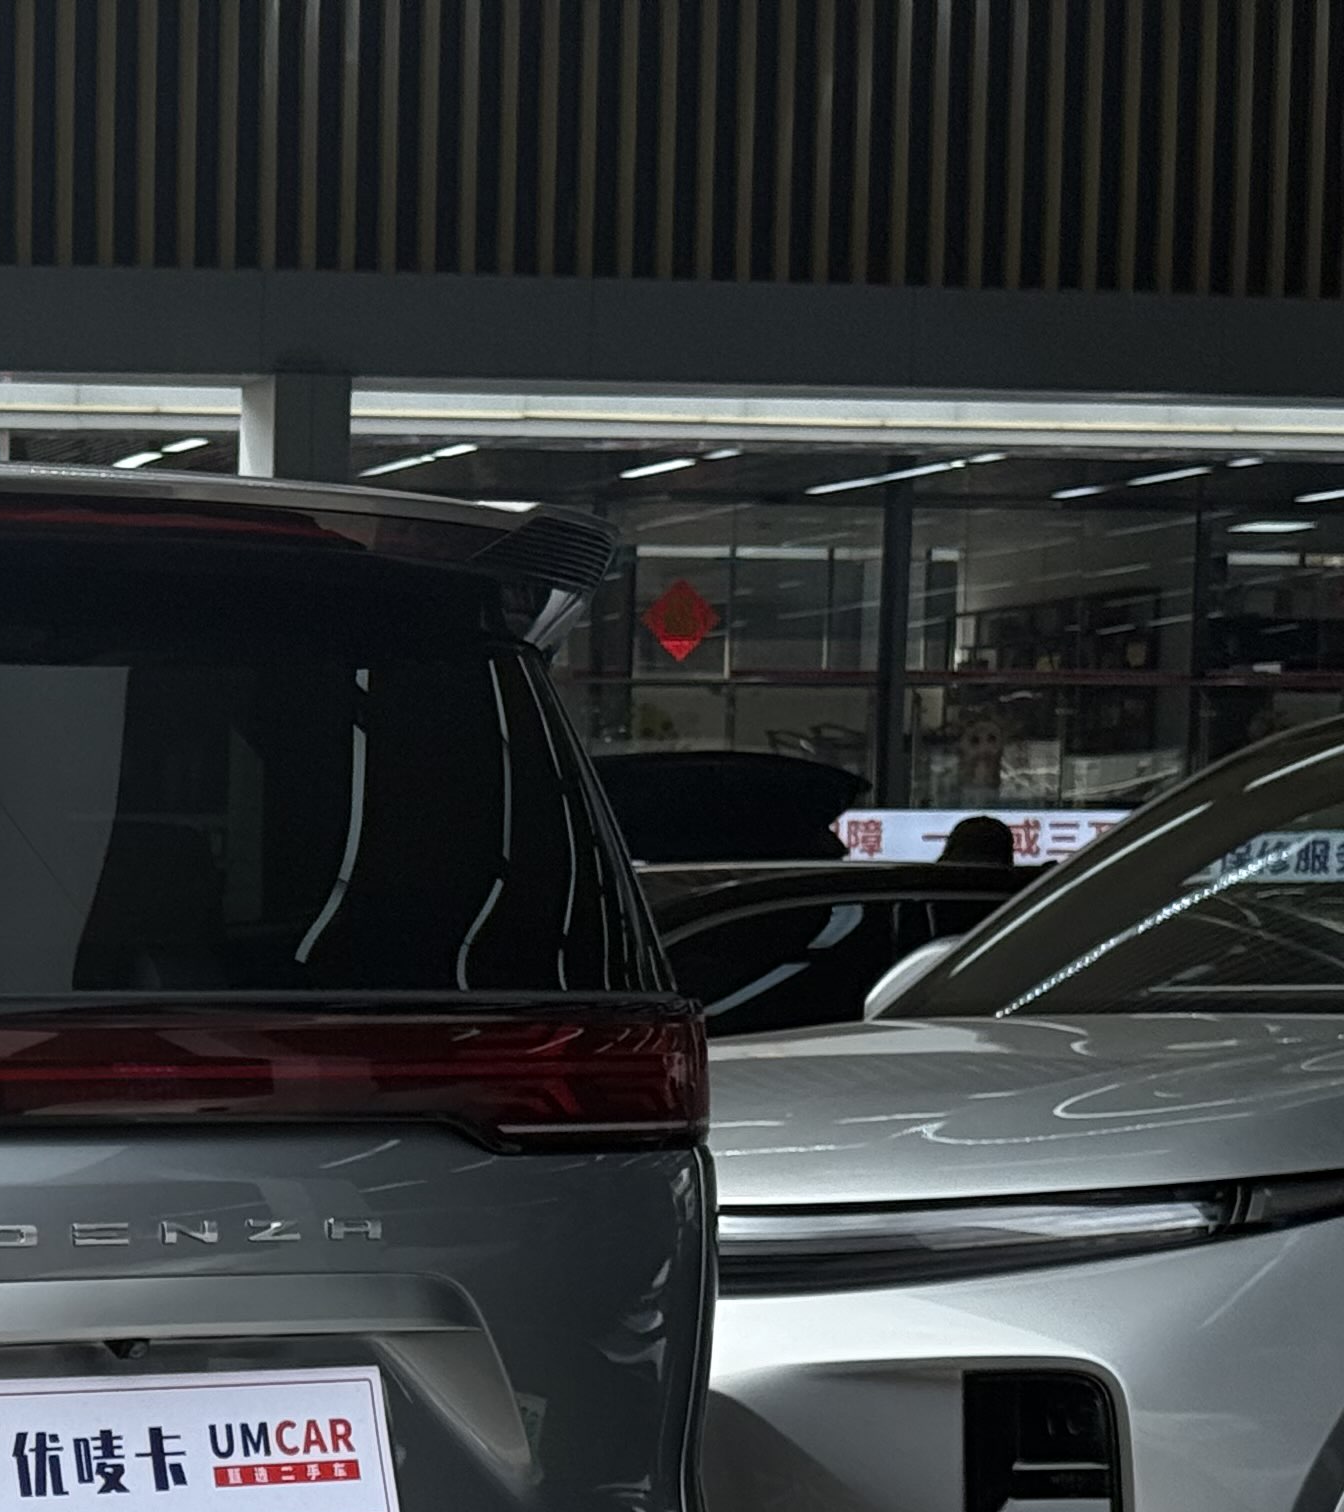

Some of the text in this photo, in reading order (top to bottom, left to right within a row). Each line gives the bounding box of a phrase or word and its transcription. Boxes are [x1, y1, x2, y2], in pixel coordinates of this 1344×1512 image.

[11, 1426, 188, 1498] 优唛卡
[208, 1418, 356, 1459] UMCAR
